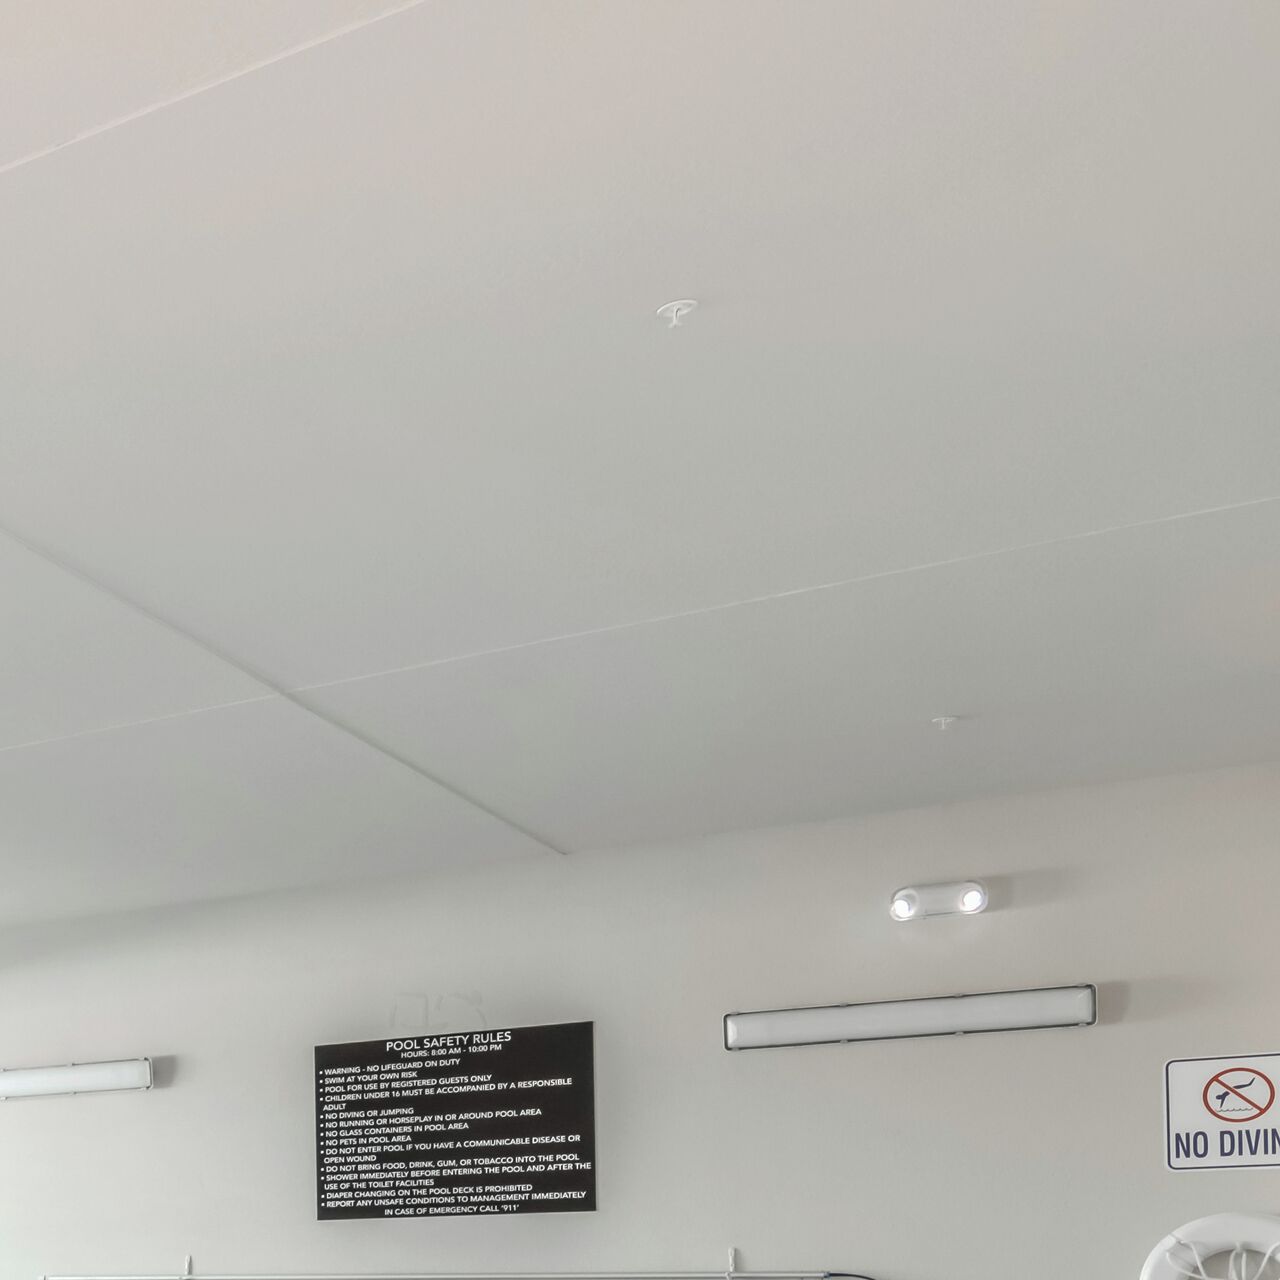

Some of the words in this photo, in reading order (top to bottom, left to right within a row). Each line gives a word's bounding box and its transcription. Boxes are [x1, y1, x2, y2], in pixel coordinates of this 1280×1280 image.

[386, 1038, 420, 1051] POOL
[423, 1034, 469, 1048] SAFETY
[472, 1030, 511, 1044] RULES
[430, 1047, 447, 1056] 8:00
[447, 1046, 461, 1054] AM
[468, 1044, 488, 1053] 10:00
[489, 1043, 501, 1051] PM
[324, 1065, 360, 1075] WARNING
[366, 1064, 379, 1072] NO
[380, 1060, 423, 1071] LIFEGUARD
[424, 1059, 437, 1067] ON
[438, 1057, 460, 1066] DUTY
[324, 1075, 345, 1084] SWIM
[356, 1073, 378, 1082] YOUR
[379, 1071, 399, 1080] OWN
[400, 1070, 417, 1078] RISK
[324, 1084, 345, 1093] POOL
[346, 1083, 362, 1092] FOR
[363, 1082, 378, 1090] USE
[379, 1081, 389, 1089] BY
[390, 1077, 437, 1088] REGISTERED
[438, 1075, 468, 1085] GUESTS
[470, 1073, 492, 1082] ONLY
[324, 1092, 361, 1102] CHILDREN
[363, 1090, 389, 1099] UNDER
[401, 1088, 423, 1096] MUST
[424, 1087, 434, 1095] BE
[435, 1082, 495, 1094] ACCOMPANIED
[497, 1081, 508, 1090] BY
[508, 1081, 516, 1089] A
[517, 1077, 572, 1088] RESPONSIBLE
[322, 1102, 346, 1111] ADULT
[325, 1112, 337, 1120] NO
[338, 1110, 365, 1119] DIVING
[366, 1109, 378, 1117] OR
[379, 1107, 414, 1116] JUMPING
[325, 1120, 337, 1128] NO
[339, 1118, 374, 1127] RUNNING
[375, 1117, 387, 1125] OR
[388, 1114, 433, 1124] HORSEPLAY
[444, 1113, 456, 1121] OR
[457, 1110, 493, 1120] AROUND
[494, 1109, 518, 1118] POOL
[519, 1107, 541, 1116] AREA
[325, 1129, 338, 1137] NO
[338, 1128, 362, 1136] GLASS
[363, 1125, 412, 1135] CONTAINERS
[413, 1124, 422, 1132] IN
[424, 1123, 446, 1131] POOL
[447, 1121, 469, 1130] AREA
[325, 1138, 338, 1146] NO
[339, 1137, 357, 1145] PETS
[368, 1135, 389, 1144] POOL
[390, 1134, 411, 1142] AREA
[325, 1147, 338, 1155] DO
[338, 1146, 356, 1154] NOT
[357, 1145, 381, 1153] ENTER
[382, 1143, 404, 1152] POOL
[414, 1142, 431, 1150] YOU
[432, 1141, 454, 1149] HAVE
[463, 1136, 530, 1148] COMMUNICABLE
[531, 1134, 565, 1144] DISEASE
[567, 1134, 580, 1142] OR
[1174, 1131, 1209, 1159] NO
[323, 1155, 344, 1164] OPEN
[345, 1154, 376, 1163] WOUND
[339, 1164, 356, 1172] NOT
[357, 1162, 381, 1171] BRING
[459, 1158, 471, 1166] OR
[472, 1156, 513, 1165] TOBACCO
[515, 1155, 536, 1163] INTO
[537, 1154, 554, 1162] THE
[555, 1152, 579, 1161] POOL
[325, 1172, 358, 1181] SHOWER
[359, 1170, 409, 1180] IMMEDIATELY
[410, 1168, 440, 1177] BEFORE
[442, 1166, 482, 1176] ENTERING
[483, 1166, 499, 1174] THE
[501, 1164, 524, 1173] POOL
[525, 1164, 545, 1172] AND
[546, 1162, 573, 1171] AFTER
[574, 1161, 591, 1170] THE
[323, 1182, 338, 1190] USE
[351, 1181, 366, 1189] THE
[367, 1180, 394, 1188] TOILET
[395, 1178, 434, 1187] FACILITIES
[326, 1191, 353, 1199] DIAPER
[353, 1189, 396, 1198] CHANGING
[397, 1188, 410, 1196] ON
[428, 1187, 451, 1195] POOL
[452, 1186, 474, 1194] DECK
[475, 1185, 483, 1193] IS
[484, 1183, 532, 1193] PROHIBITED
[326, 1199, 355, 1207] REPORT
[373, 1197, 403, 1206] UNSAFE
[405, 1195, 455, 1204] CONDITIONS
[469, 1192, 529, 1202] MANAGEMENT
[531, 1190, 586, 1200] IMMEDIATELY
[394, 1207, 414, 1215] CASE
[428, 1205, 478, 1214] EMERGENCY
[479, 1204, 499, 1212] CALL
